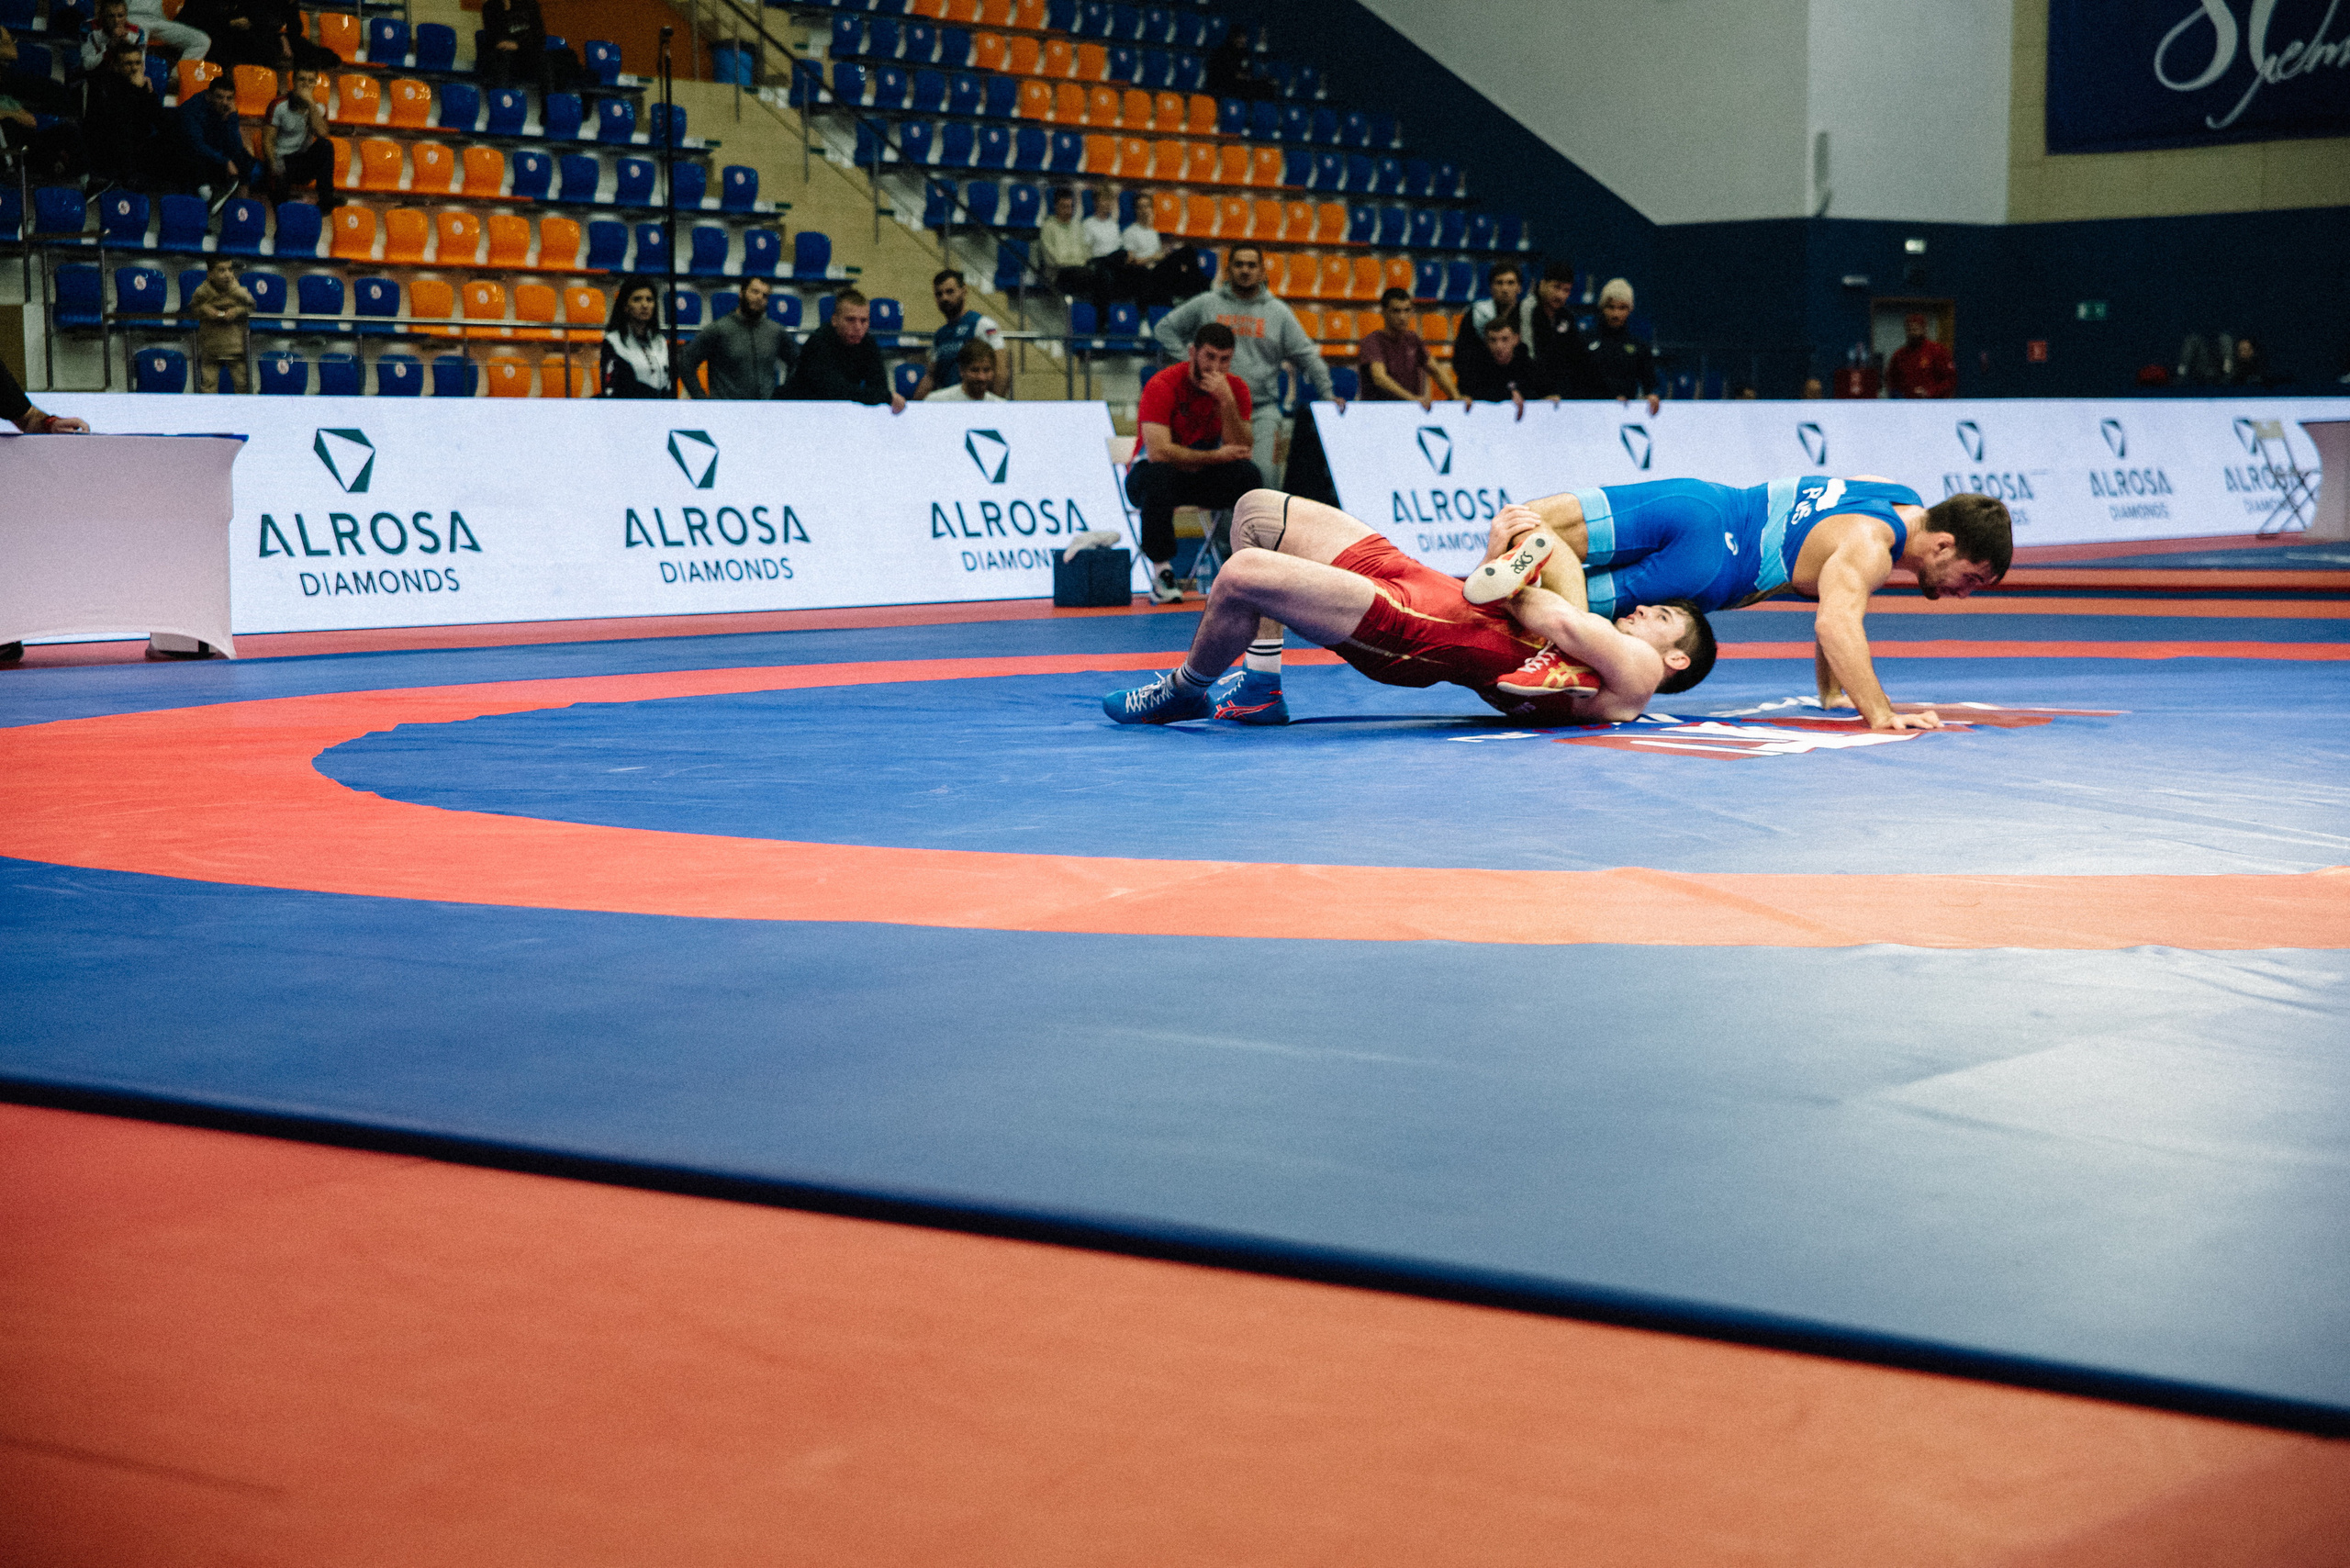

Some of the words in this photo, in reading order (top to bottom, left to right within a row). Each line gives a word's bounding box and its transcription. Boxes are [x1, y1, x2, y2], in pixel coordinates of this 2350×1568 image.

[2089, 467, 2173, 497] ALROSA
[625, 505, 811, 548] ALROSA
[932, 498, 1089, 538] ALROSA
[259, 510, 483, 557] ALROSA
[1417, 532, 1489, 552] DIAMON
[660, 557, 793, 583] DIAMONDS
[962, 549, 1053, 571] DIAMON
[299, 566, 460, 597] DIAMONDS
